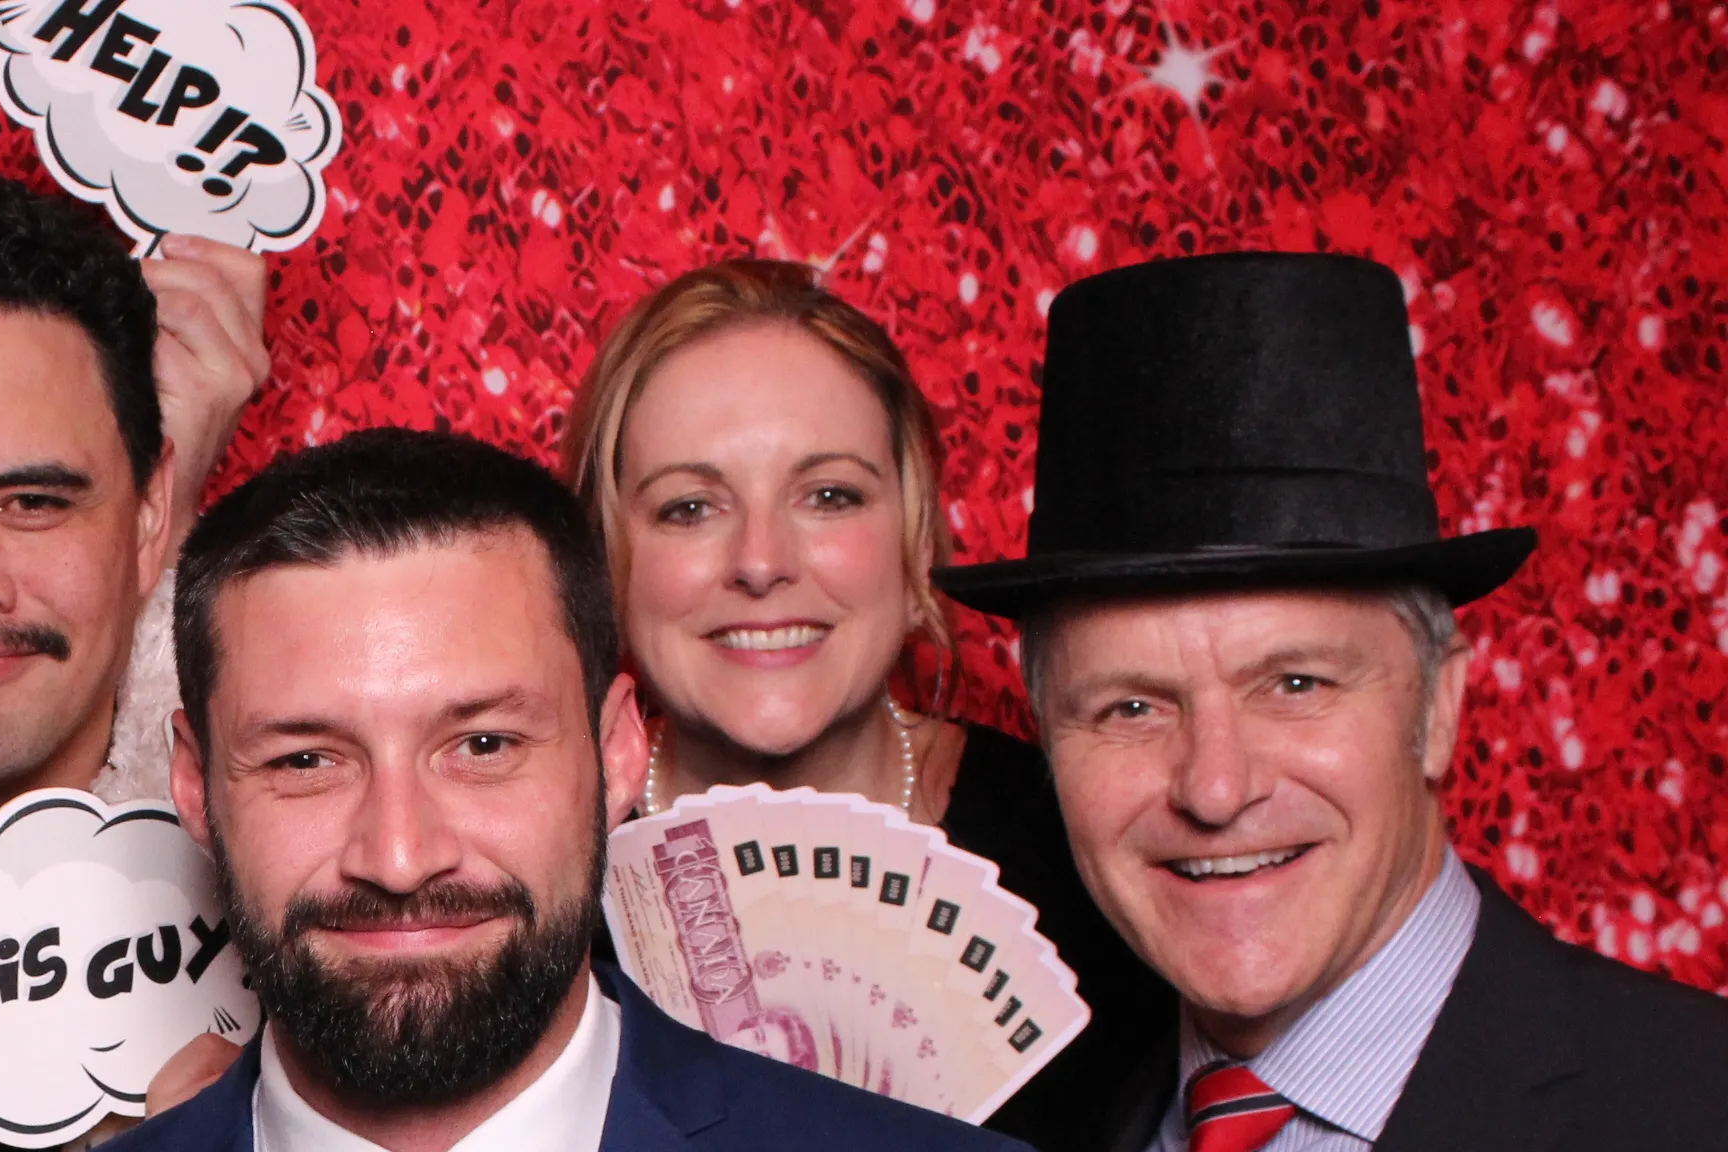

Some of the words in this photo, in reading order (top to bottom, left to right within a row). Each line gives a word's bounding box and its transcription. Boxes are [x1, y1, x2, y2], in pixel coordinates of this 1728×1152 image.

[34, 0, 286, 196] HELP!?
[87, 913, 252, 999] GUY
[674, 850, 735, 1005] CANADA
